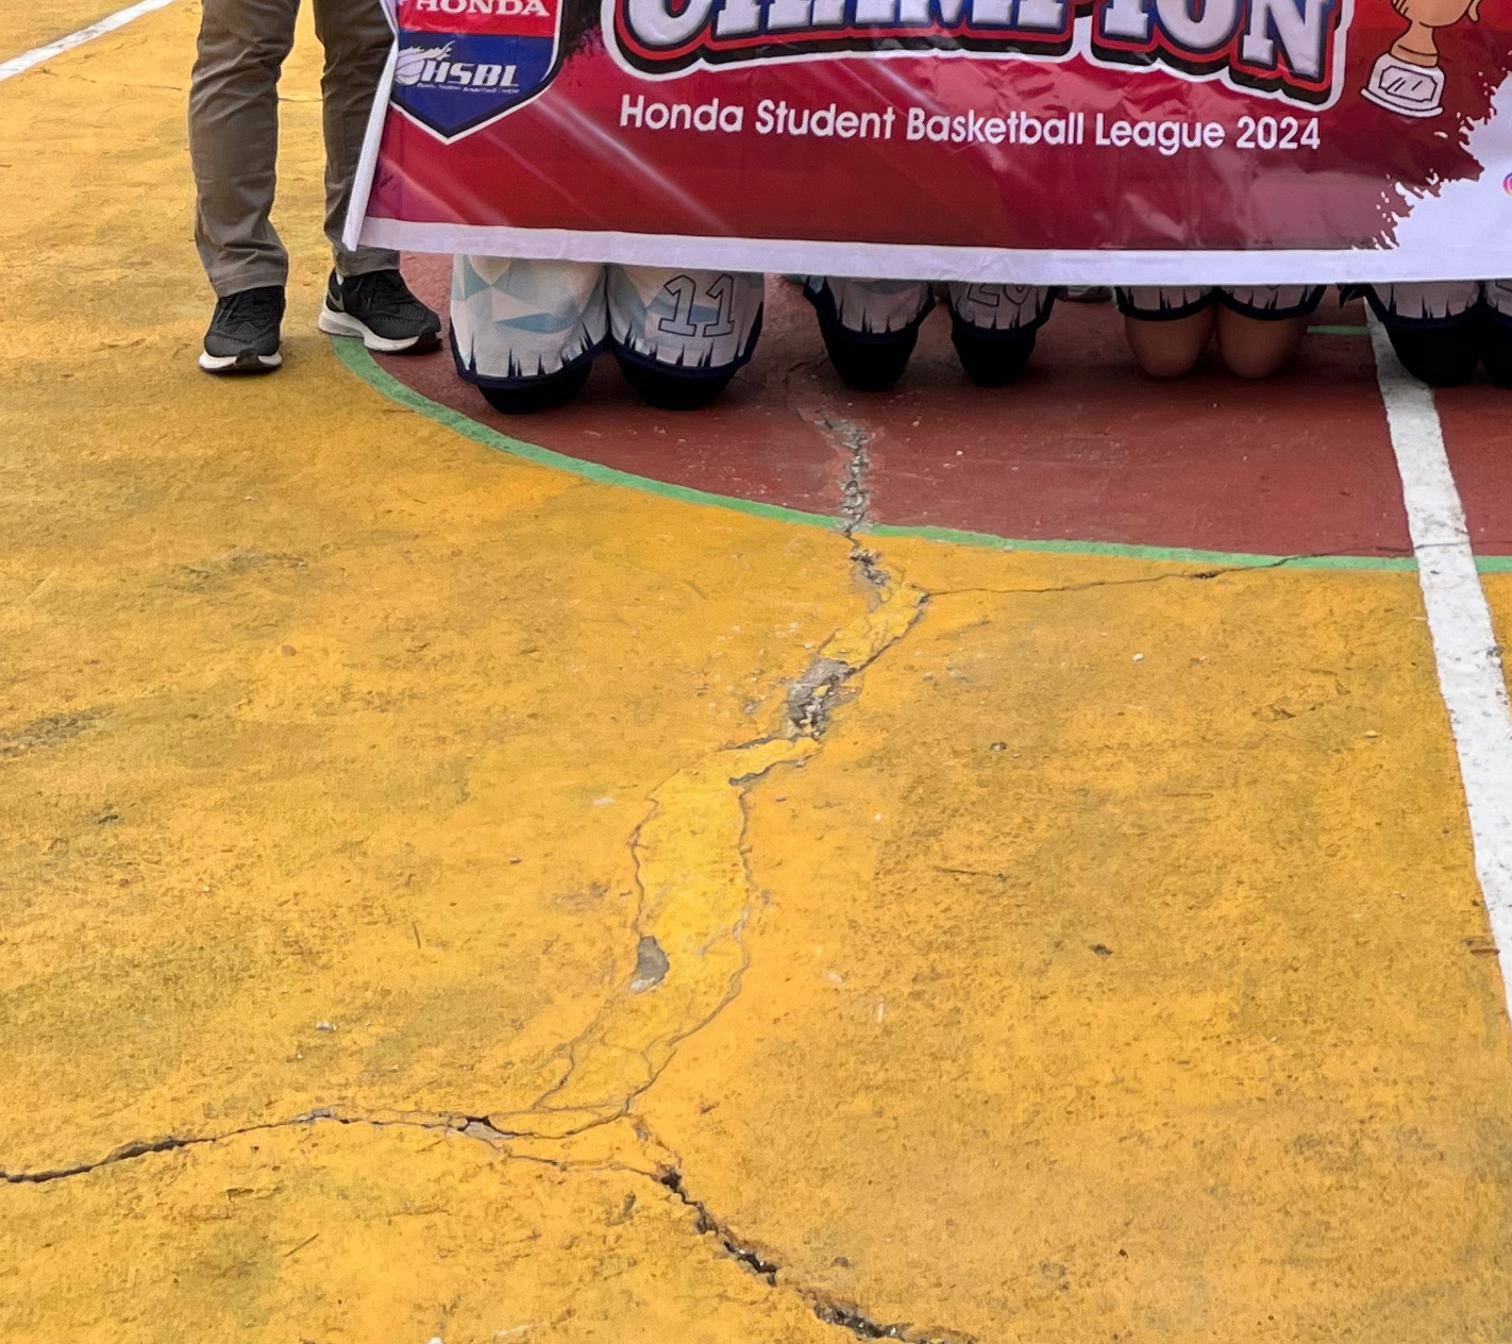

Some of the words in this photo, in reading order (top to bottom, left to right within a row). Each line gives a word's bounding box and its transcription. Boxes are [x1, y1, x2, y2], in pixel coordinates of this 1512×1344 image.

[420, 59, 521, 88] HSBL
[619, 93, 745, 133] Honda
[754, 98, 896, 140] Student
[906, 106, 1084, 146] Basketball
[1095, 112, 1225, 156] League
[1236, 116, 1322, 152] 2024
[657, 273, 736, 339] 11
